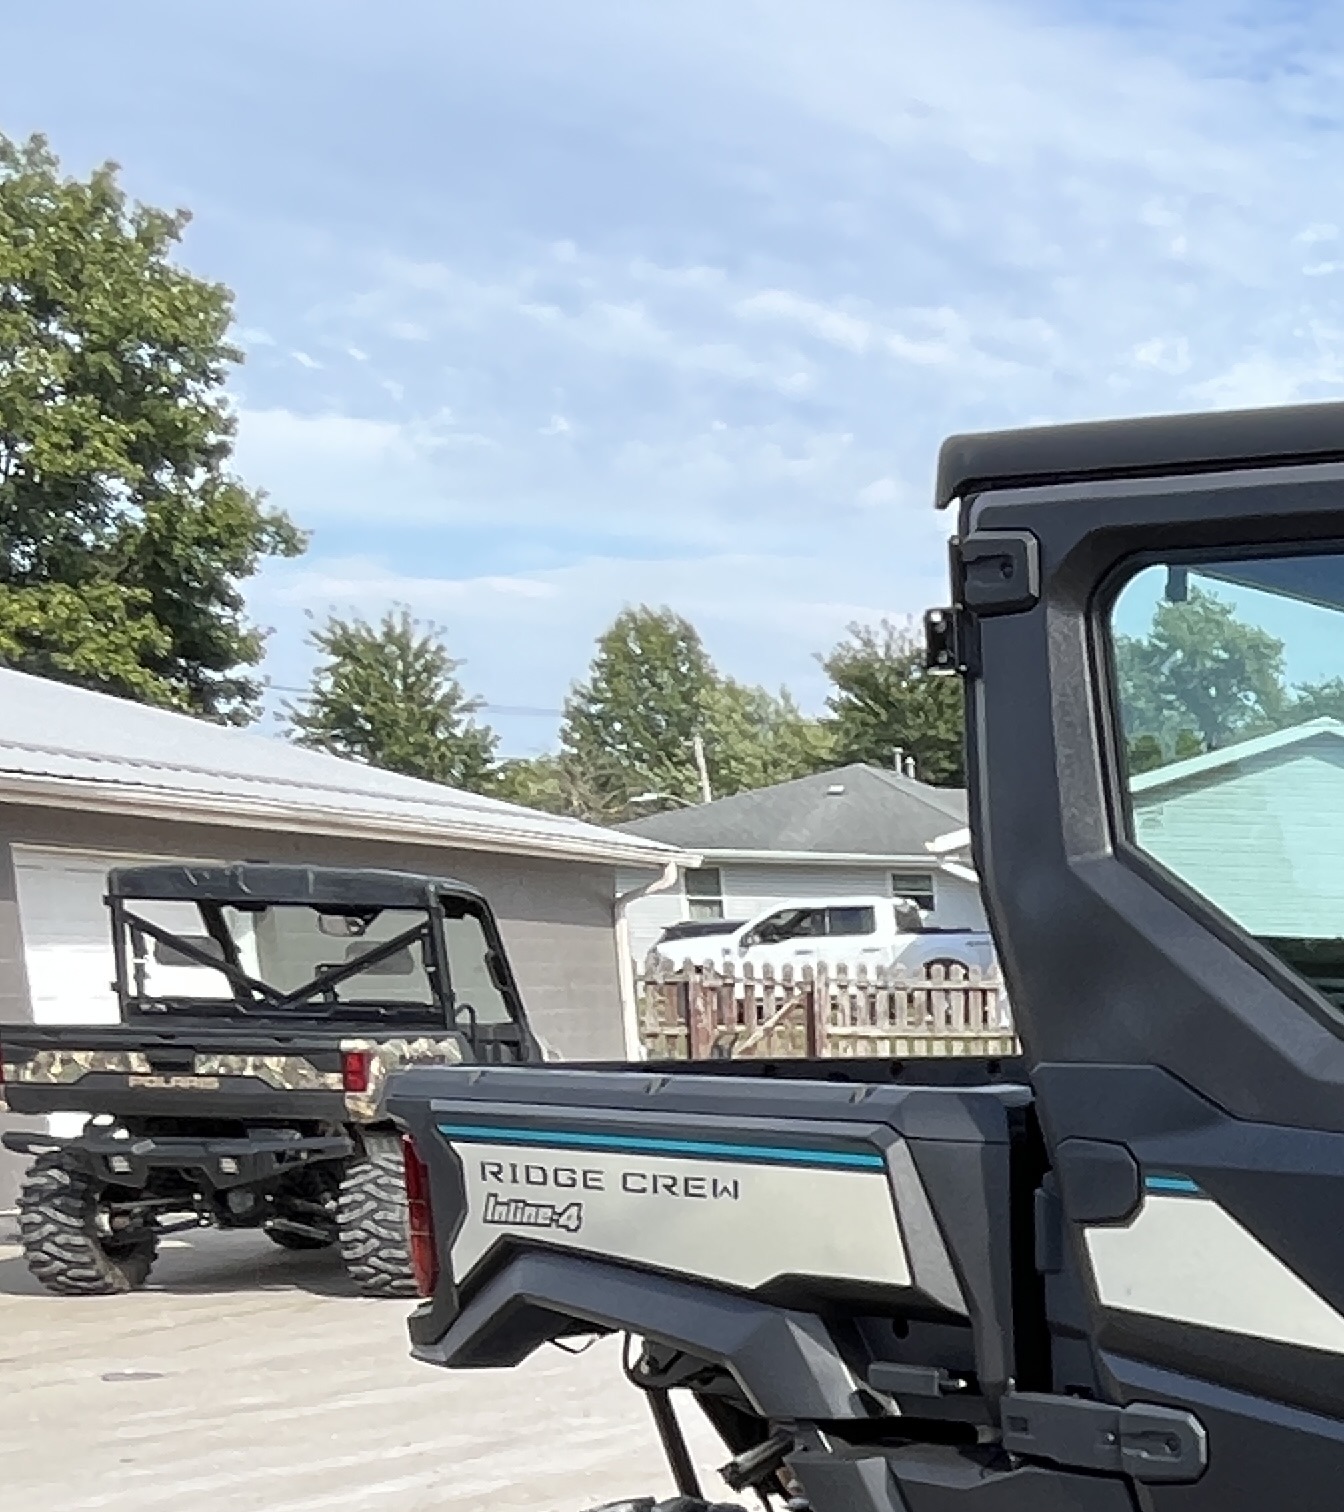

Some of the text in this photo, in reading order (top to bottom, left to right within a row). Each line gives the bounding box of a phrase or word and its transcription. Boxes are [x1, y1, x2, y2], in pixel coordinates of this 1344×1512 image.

[480, 1161, 740, 1200] RIDGE CREW
[483, 1192, 583, 1232] Inline-4
